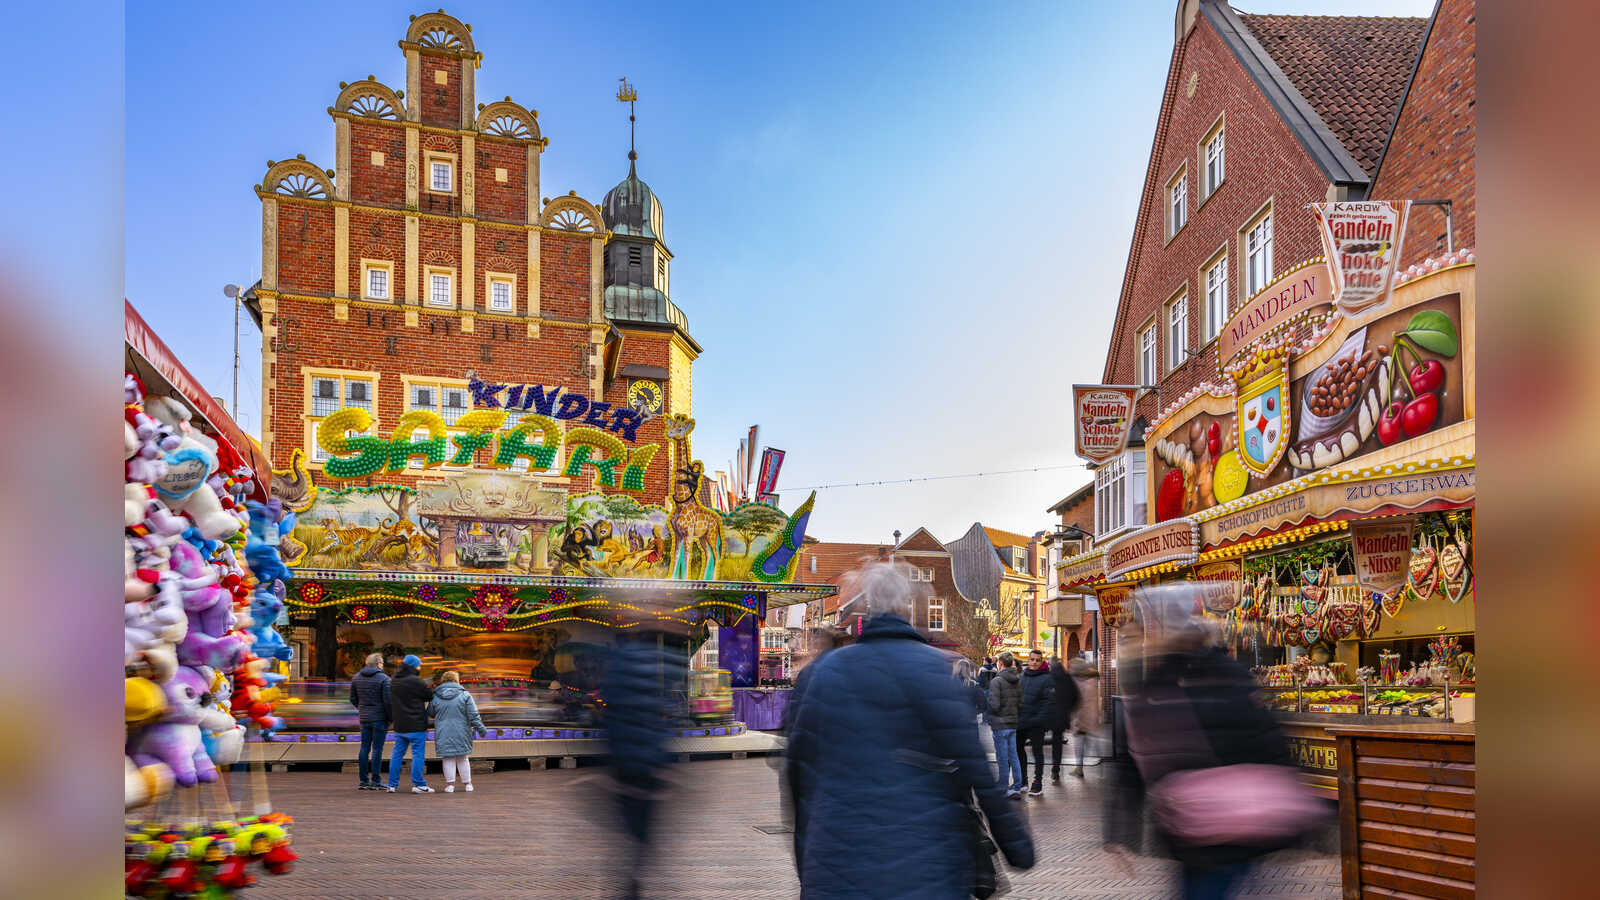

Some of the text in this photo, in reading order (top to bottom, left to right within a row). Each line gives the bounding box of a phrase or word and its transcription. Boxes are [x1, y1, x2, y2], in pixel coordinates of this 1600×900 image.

[1334, 203, 1380, 212] KAROW
[1232, 276, 1316, 346] MANDELN
[467, 378, 645, 443] KINDER
[1082, 403, 1126, 417] Mandeln
[1083, 423, 1126, 434] Schoko-
[1083, 433, 1119, 446] früchte
[317, 406, 661, 492] SAFARI
[1218, 496, 1306, 533] SCHOKOFRÜCHTE
[1110, 536, 1161, 568] GEBRANNTE
[1356, 534, 1409, 555] Mandeln
